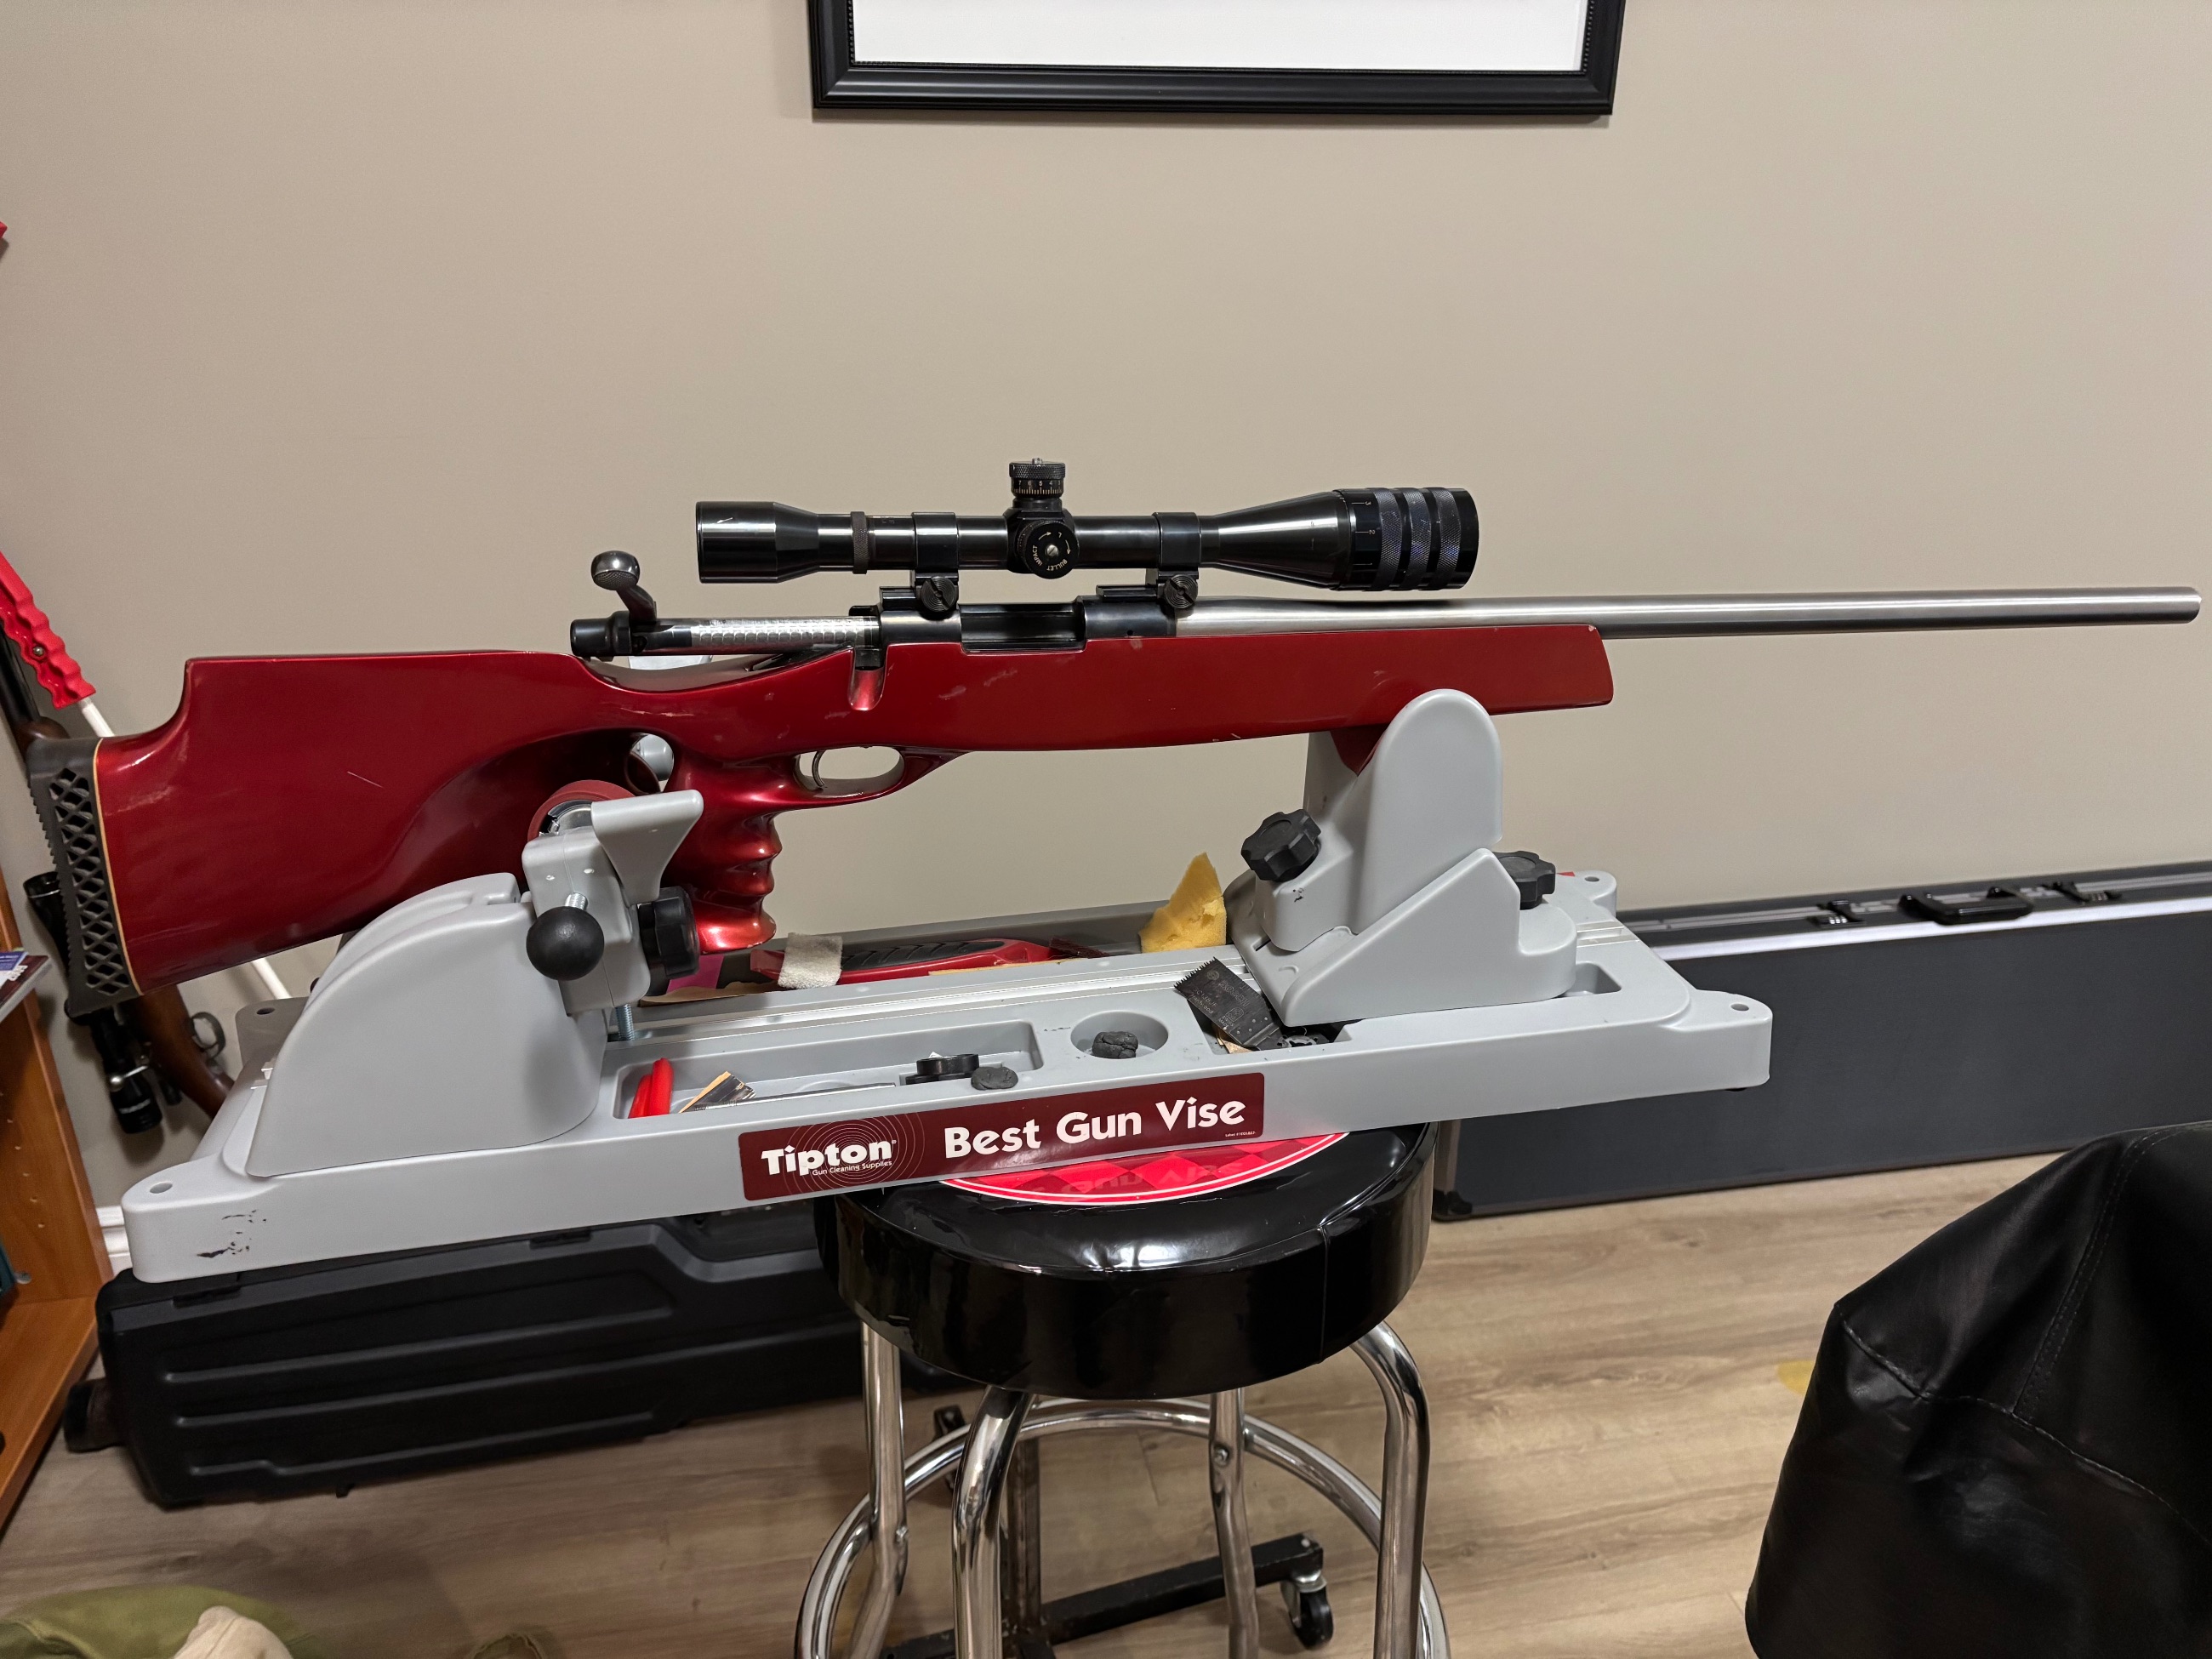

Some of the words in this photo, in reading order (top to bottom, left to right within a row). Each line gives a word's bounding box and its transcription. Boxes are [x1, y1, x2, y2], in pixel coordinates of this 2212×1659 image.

[1032, 544, 1043, 567] IMPACT
[1046, 558, 1068, 571] BULLET
[944, 1119, 1041, 1158] Best
[1056, 1111, 1142, 1144] Gun
[1155, 1097, 1246, 1131] Vise
[830, 1163, 860, 1173] Cleaning
[861, 1160, 892, 1170] Supplies
